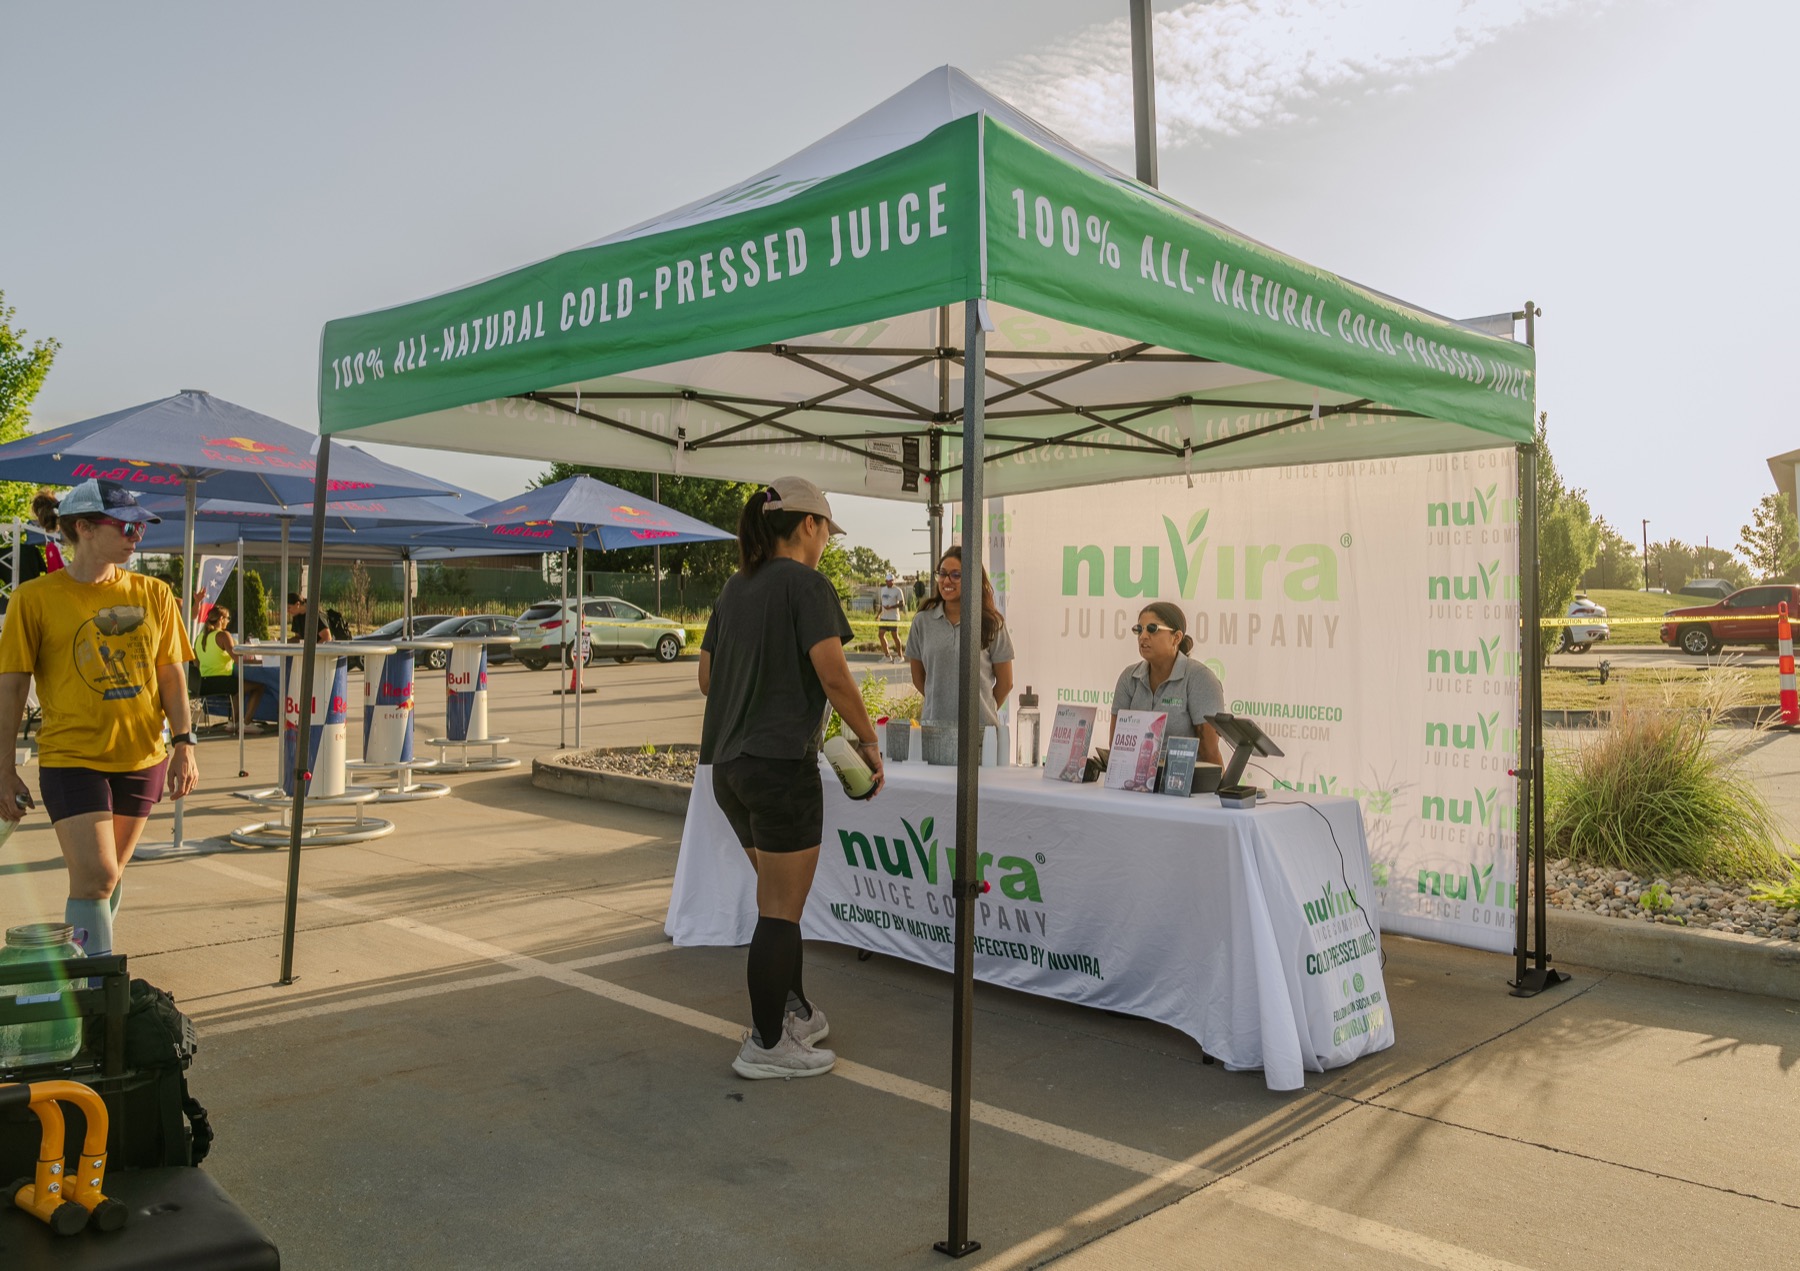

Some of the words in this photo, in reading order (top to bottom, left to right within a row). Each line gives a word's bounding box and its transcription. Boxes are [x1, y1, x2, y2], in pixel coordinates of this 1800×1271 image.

[332, 347, 384, 390] 100%
[393, 301, 545, 374] ALL-NATURAL
[560, 227, 807, 331] COLD-PRESSED
[830, 183, 948, 267] JUICE
[1012, 188, 1120, 270] 100%
[1140, 235, 1331, 338] ALL-NATURAL
[1337, 308, 1486, 385] COLD-PRESSED
[1487, 360, 1528, 401] JUICE
[201, 449, 265, 466] Red
[1427, 455, 1469, 472] JUICE
[1279, 464, 1318, 480] JUICE
[1327, 459, 1399, 478] COMPANY
[1428, 530, 1472, 546] JUICE
[1429, 604, 1473, 620] JUICE
[1061, 607, 1127, 640] JUIC
[1195, 611, 1340, 649] OMPANY
[448, 672, 470, 685] Bull
[1427, 677, 1473, 695] JUICE
[383, 682, 411, 697] Red
[1057, 688, 1100, 704] FOLLOW
[286, 696, 316, 714] Bul
[1230, 699, 1343, 722] @NUVIRAJUICECO
[1053, 726, 1072, 740] AURA
[1115, 733, 1137, 747] OASIS
[1258, 721, 1331, 742] JUICE.COM
[1425, 751, 1470, 769] JUICE
[1420, 824, 1466, 845] JUICE
[854, 874, 915, 910] JUICE
[926, 891, 1046, 937] COPANY
[893, 914, 906, 932] BY
[973, 936, 1029, 961] RFECTED
[1031, 945, 1045, 968] BY
[1047, 950, 1105, 981] NUVIRA.
